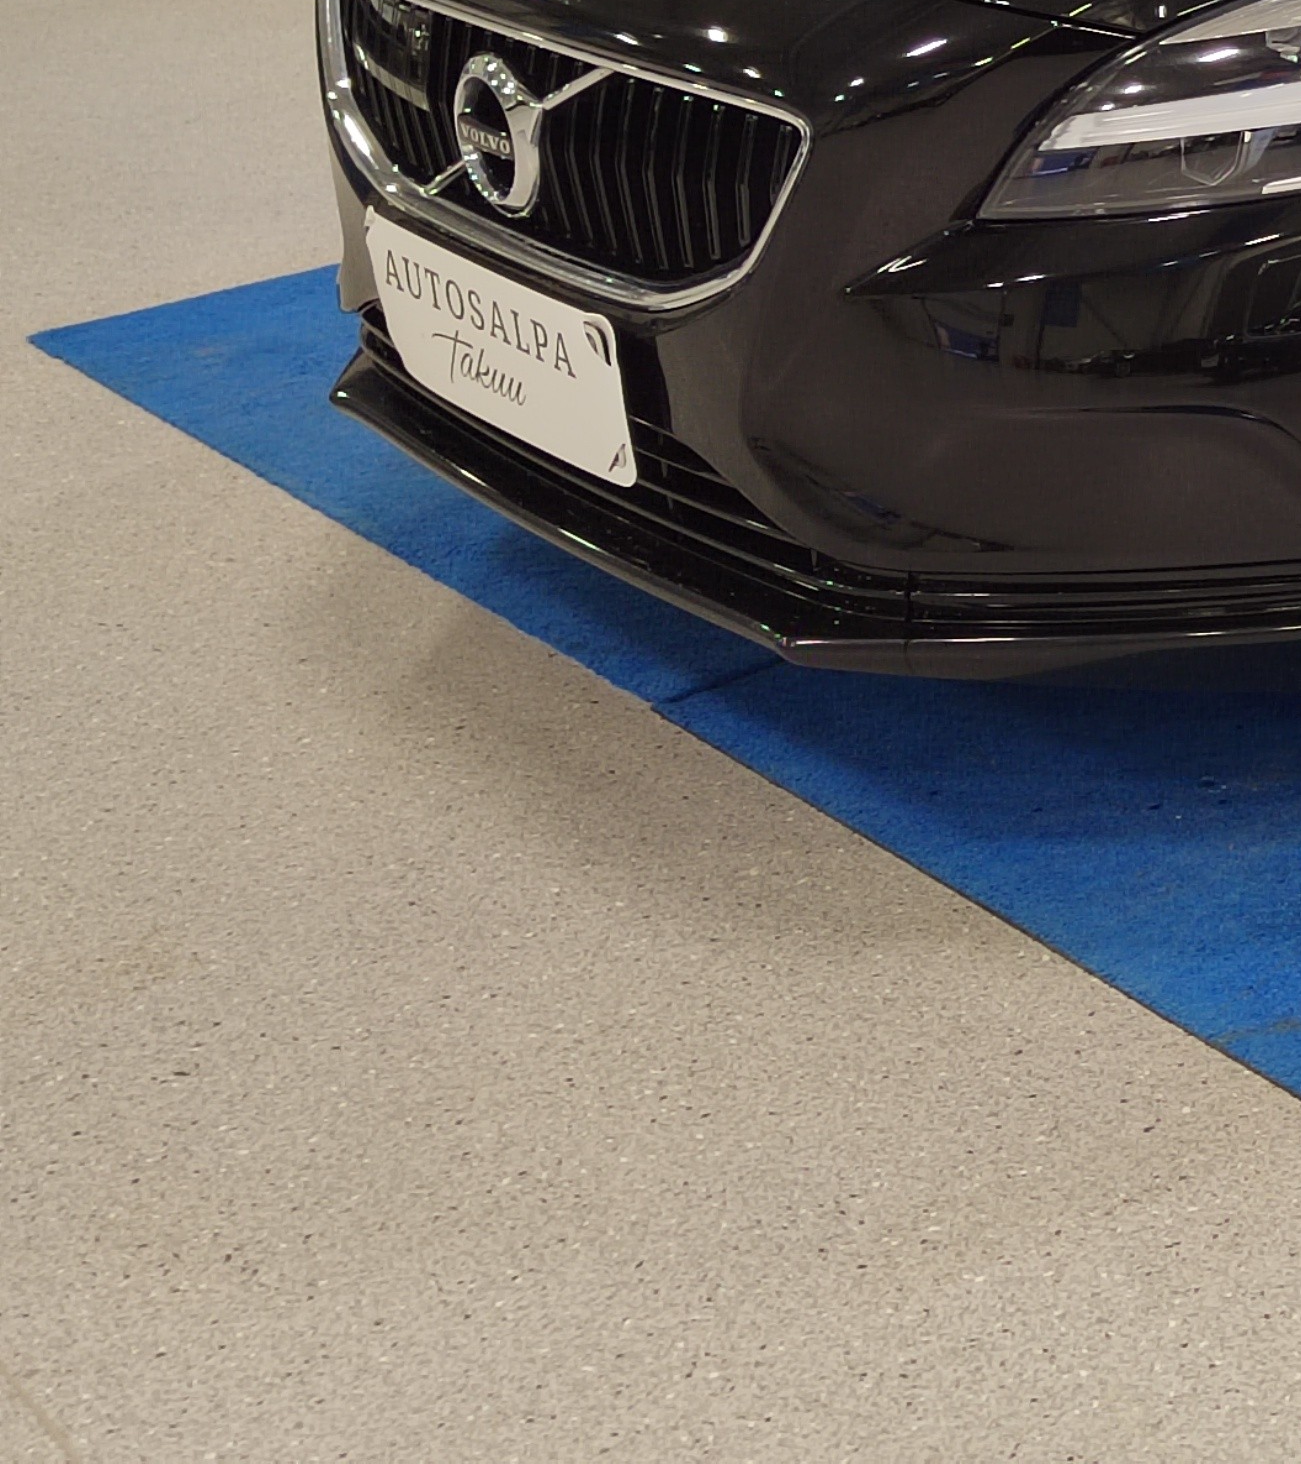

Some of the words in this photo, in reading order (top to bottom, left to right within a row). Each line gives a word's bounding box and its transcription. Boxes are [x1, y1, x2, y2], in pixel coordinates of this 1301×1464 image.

[460, 121, 511, 154] VOLVO
[386, 249, 577, 379] AUTOSALPA
[431, 329, 527, 407] Takuu
